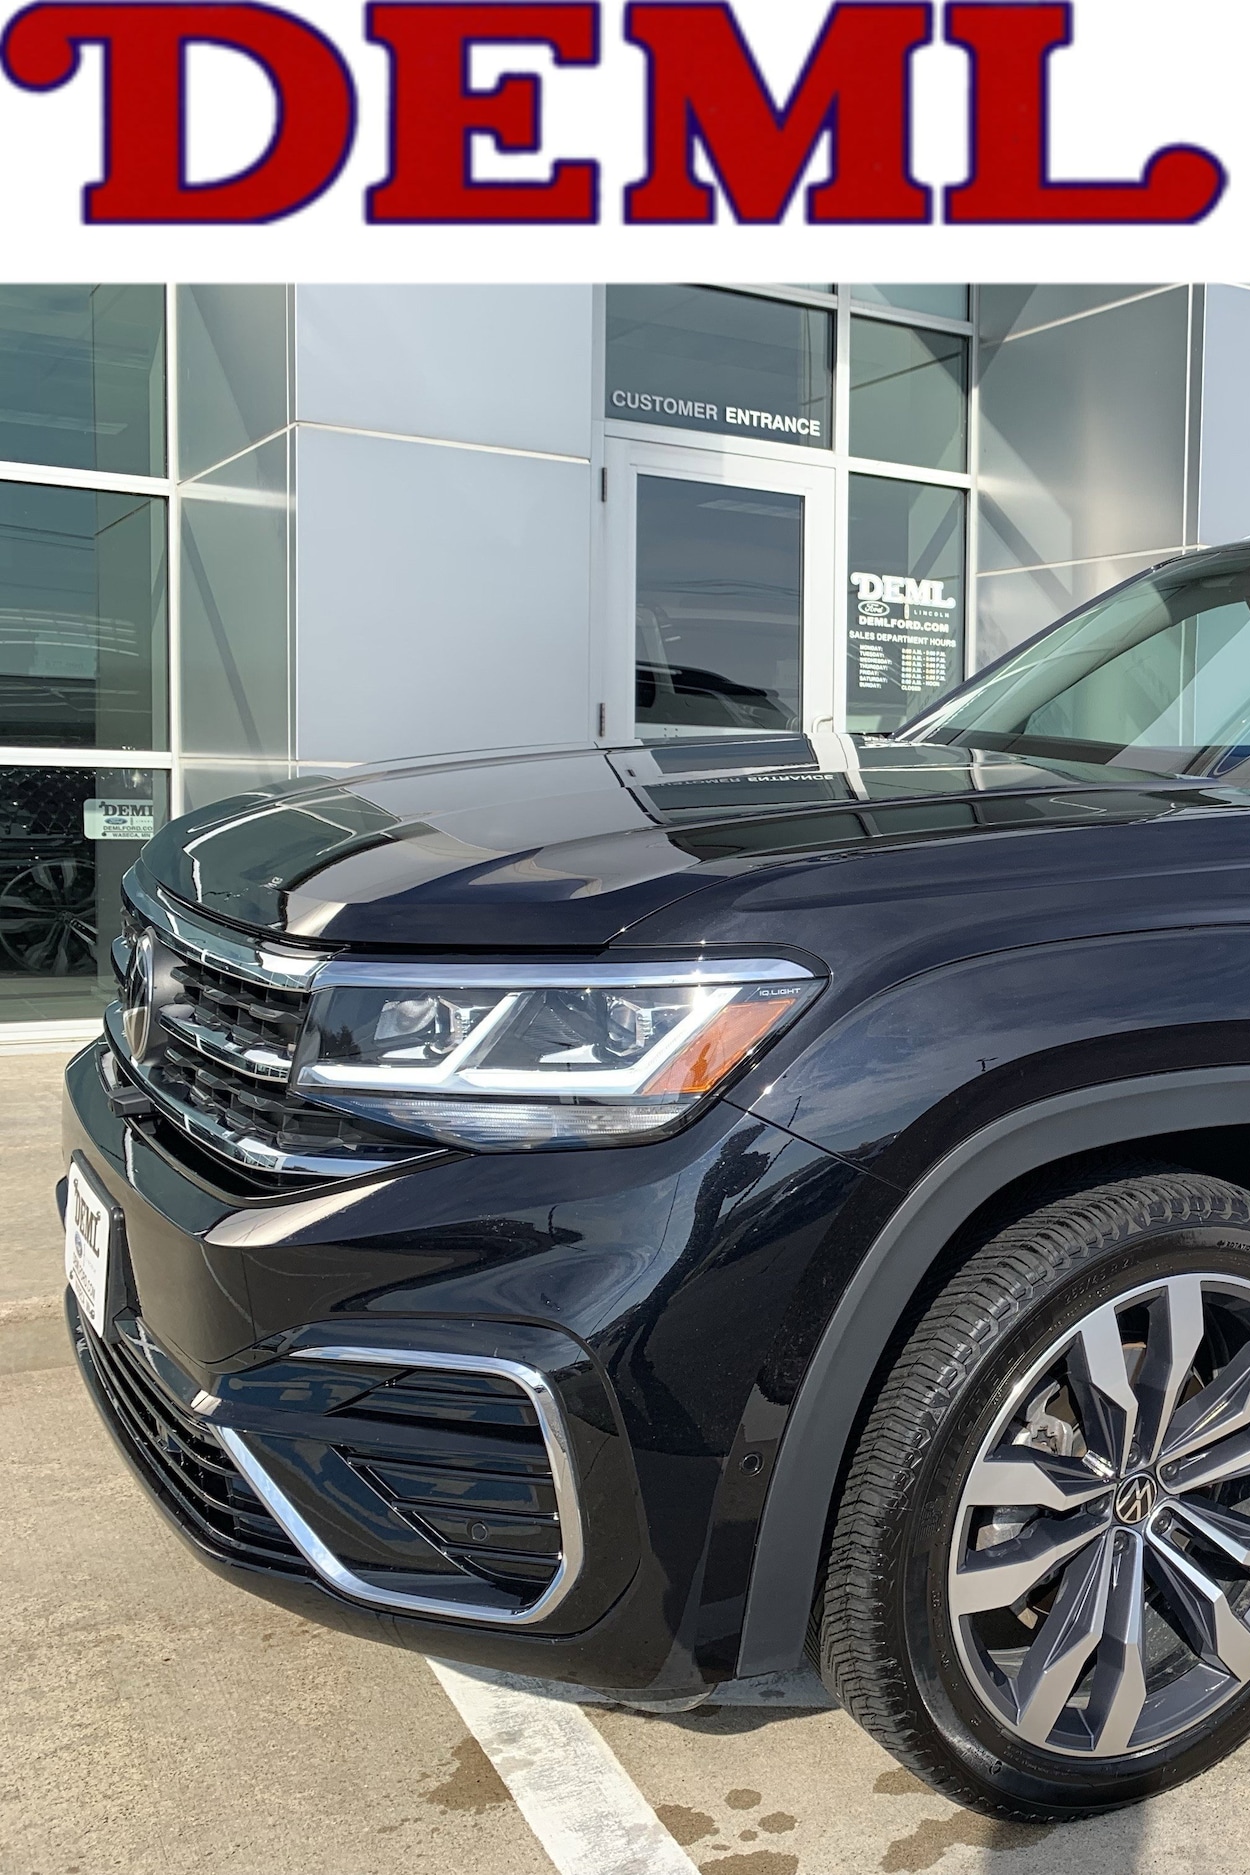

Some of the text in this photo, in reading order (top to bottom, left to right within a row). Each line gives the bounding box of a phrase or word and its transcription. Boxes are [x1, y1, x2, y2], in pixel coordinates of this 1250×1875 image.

[612, 390, 821, 437] CUSTOMER ENTRANCE
[850, 572, 957, 609] DEML
[913, 609, 950, 618] LINCOLN
[859, 615, 949, 633] DEMLFORD.COM
[849, 630, 957, 648] SALES DEPARTMENT HOURS
